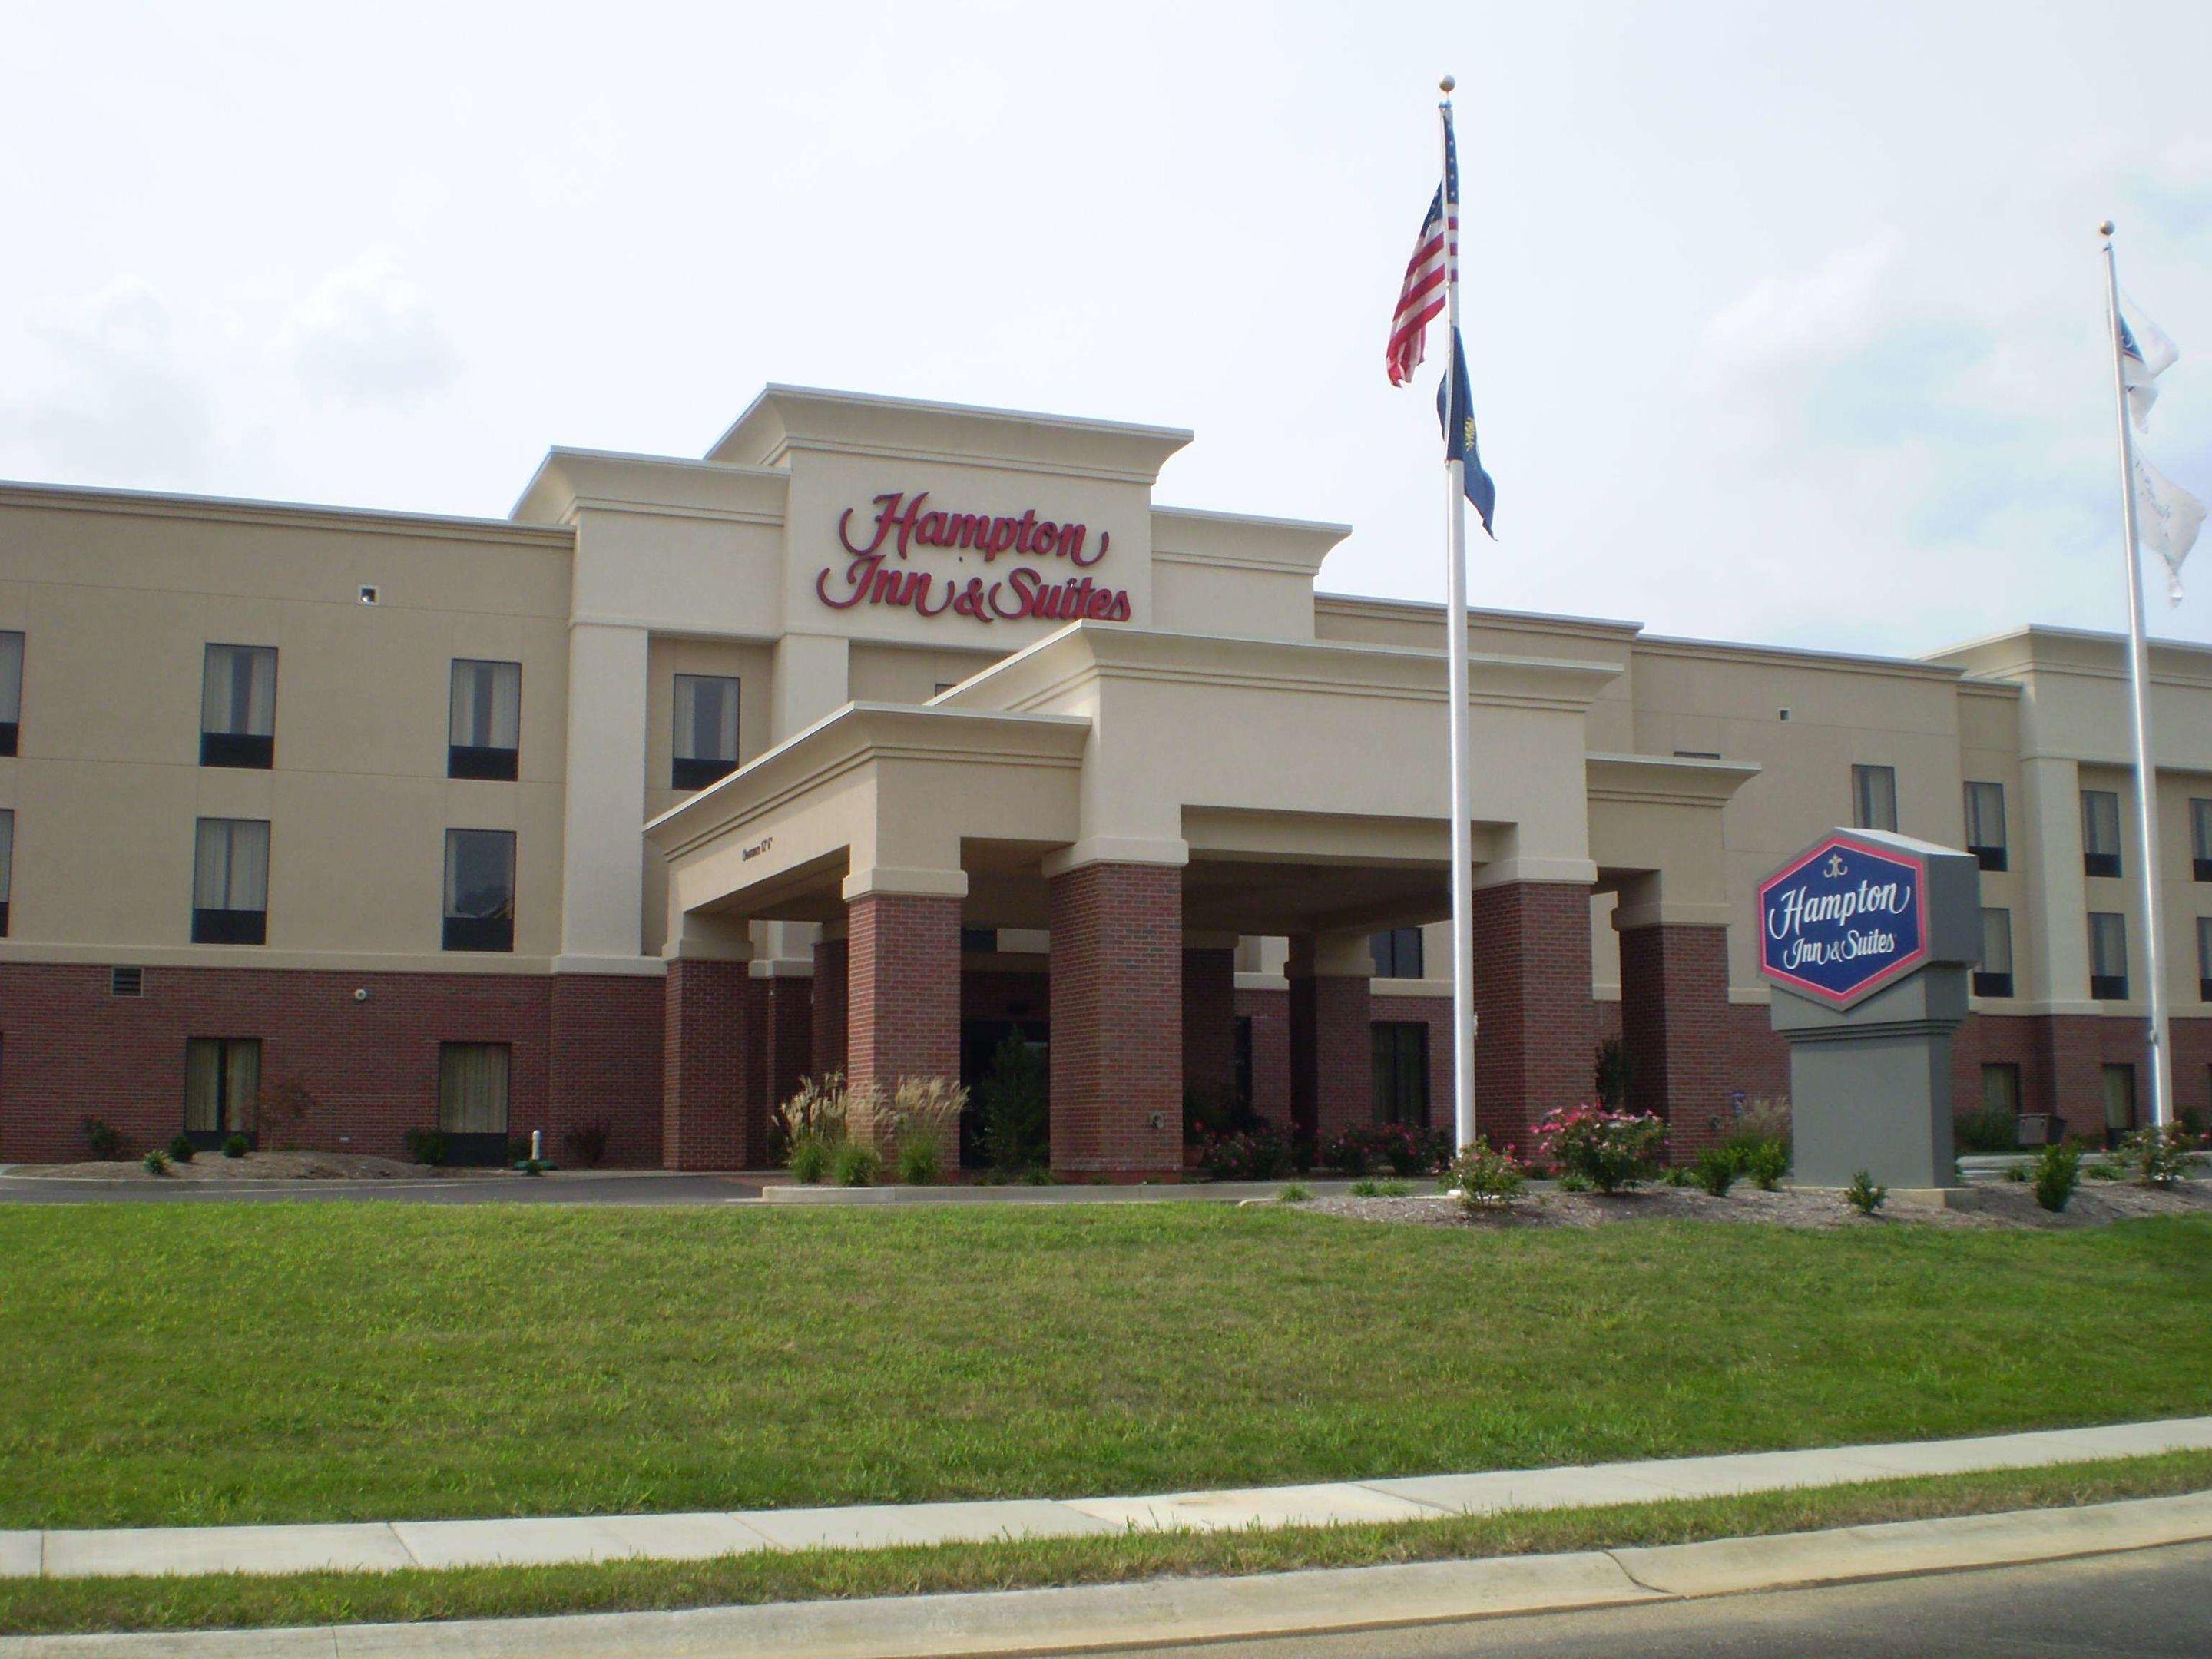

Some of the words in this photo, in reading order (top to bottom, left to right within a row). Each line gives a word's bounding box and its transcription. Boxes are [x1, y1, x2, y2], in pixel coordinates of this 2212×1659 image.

[839, 492, 1110, 568] Hampton
[816, 554, 955, 618] Inn
[954, 577, 994, 624] &
[988, 567, 1131, 622] Suites
[1769, 879, 1911, 939] Hampton
[1783, 937, 1830, 970] Inn
[1830, 942, 1843, 962] &
[1840, 929, 1895, 959] Suites
